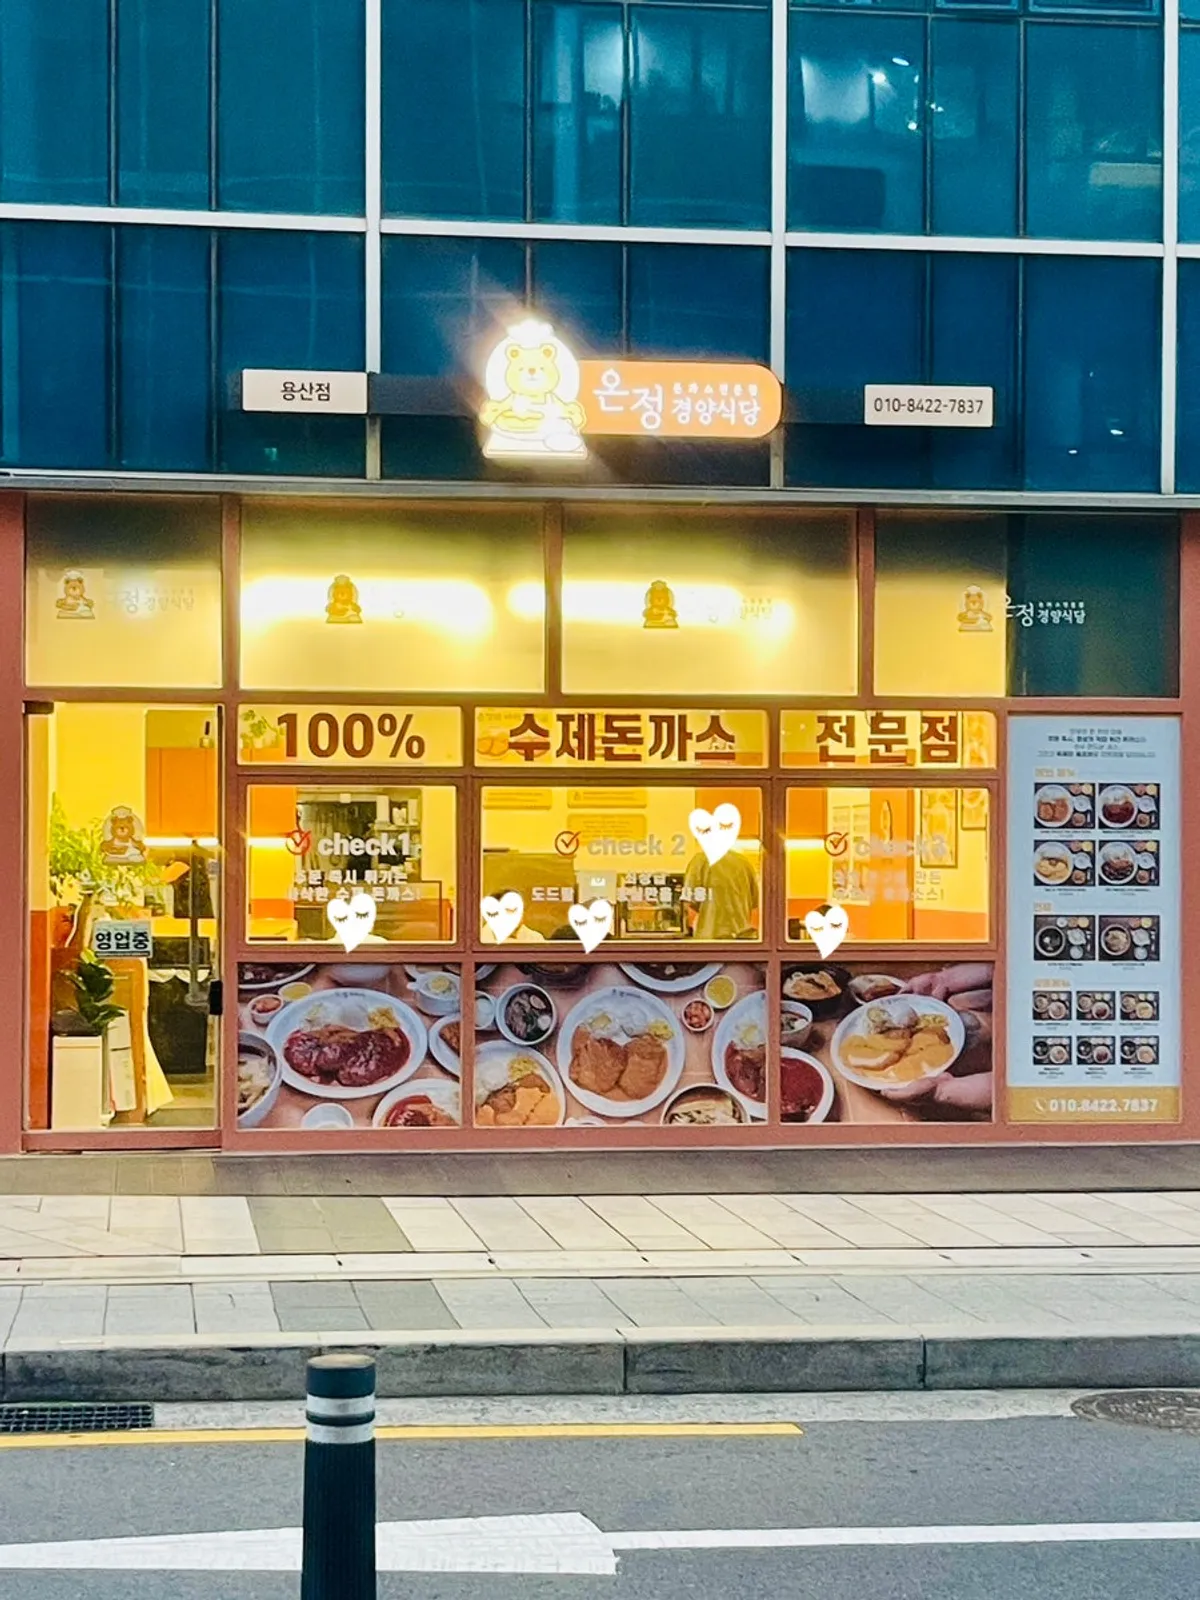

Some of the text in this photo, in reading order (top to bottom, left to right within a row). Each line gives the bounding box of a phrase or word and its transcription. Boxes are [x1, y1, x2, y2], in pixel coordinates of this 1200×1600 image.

[281, 382, 331, 401] 용산점
[592, 367, 663, 430] 온정
[672, 397, 761, 426] 경양식당
[874, 397, 983, 415] 010-8422-7837
[277, 712, 958, 763] 100% 수제돈까스 전문점
[588, 834, 685, 855] check 2
[96, 931, 149, 950] 영업중
